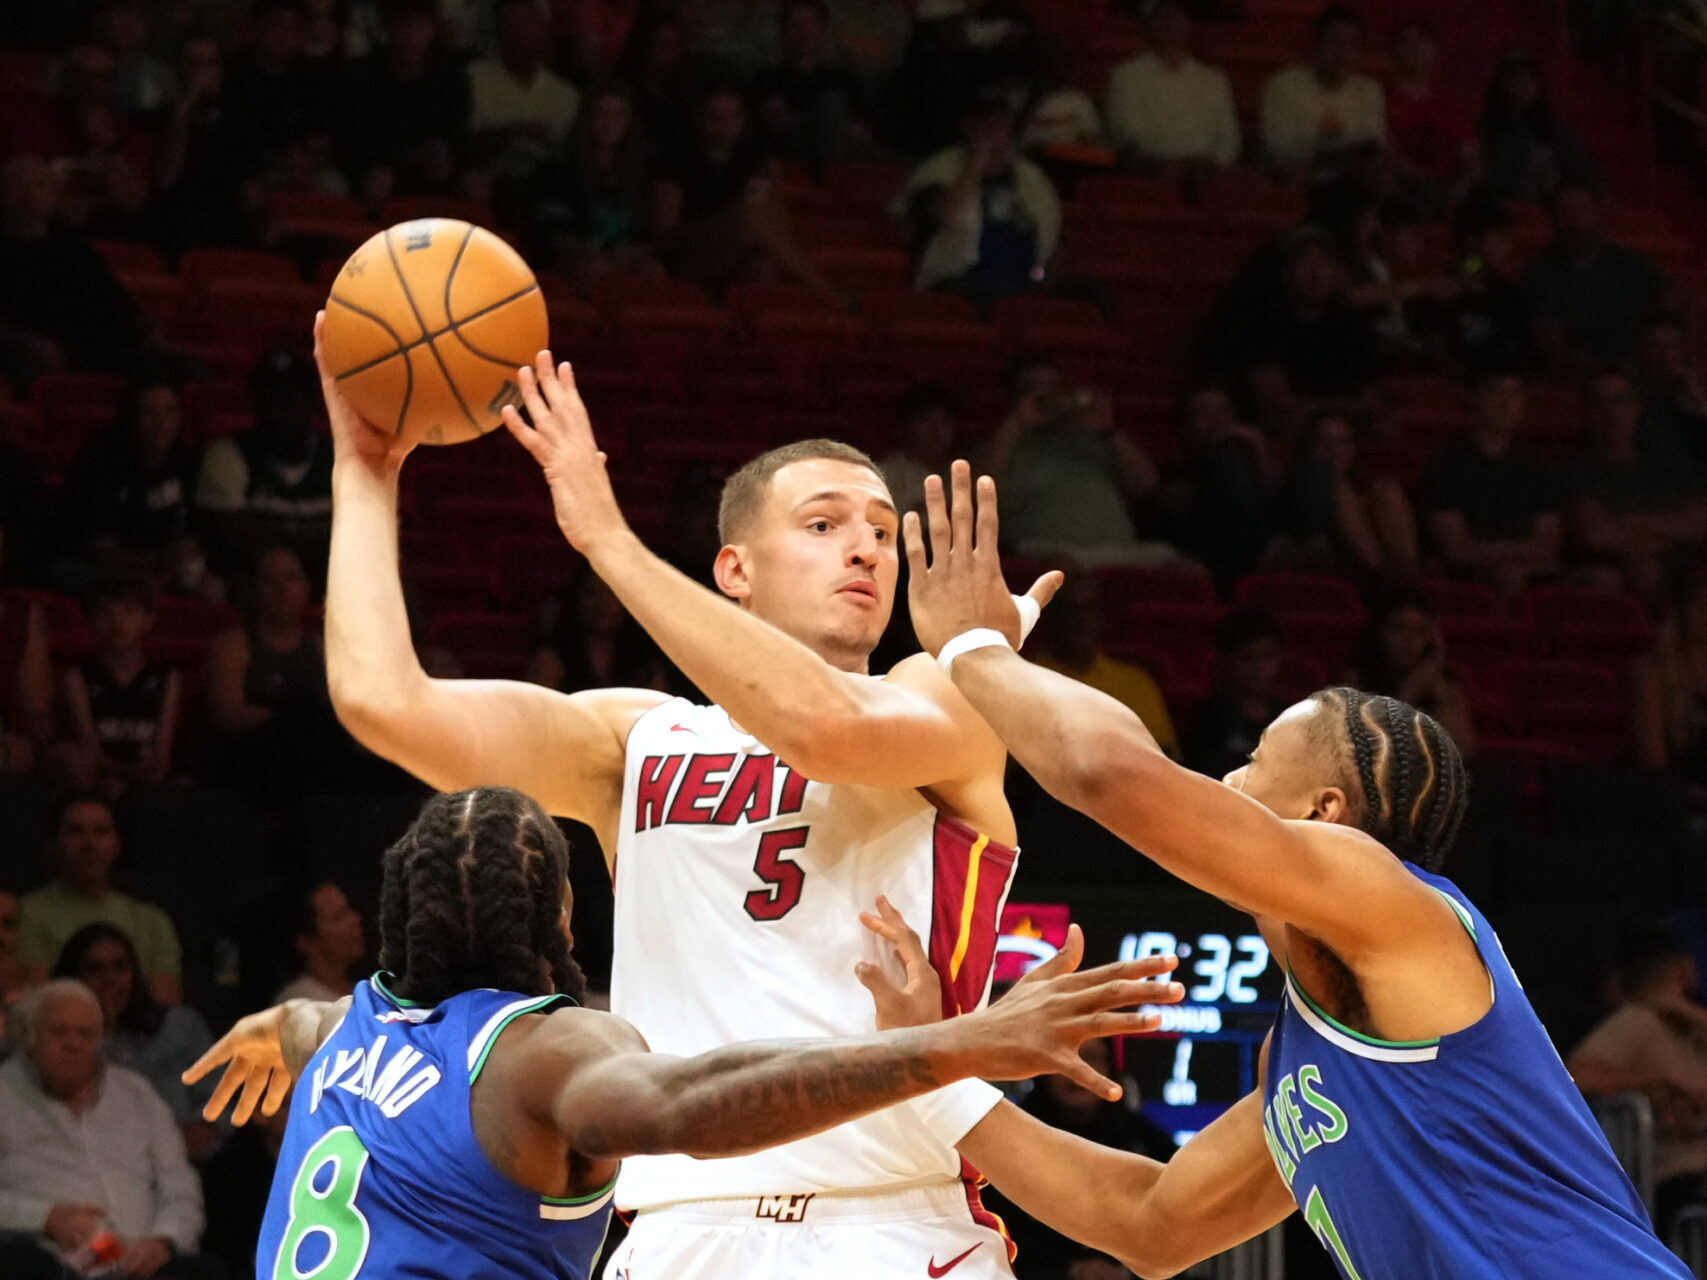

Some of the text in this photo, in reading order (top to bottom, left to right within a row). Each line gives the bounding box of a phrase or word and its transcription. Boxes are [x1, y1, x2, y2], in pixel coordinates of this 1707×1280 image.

[634, 752, 809, 833] HEAT
[743, 825, 811, 921] 5
[1172, 1038, 1193, 1081] 1
[1264, 1064, 1348, 1202] LVES
